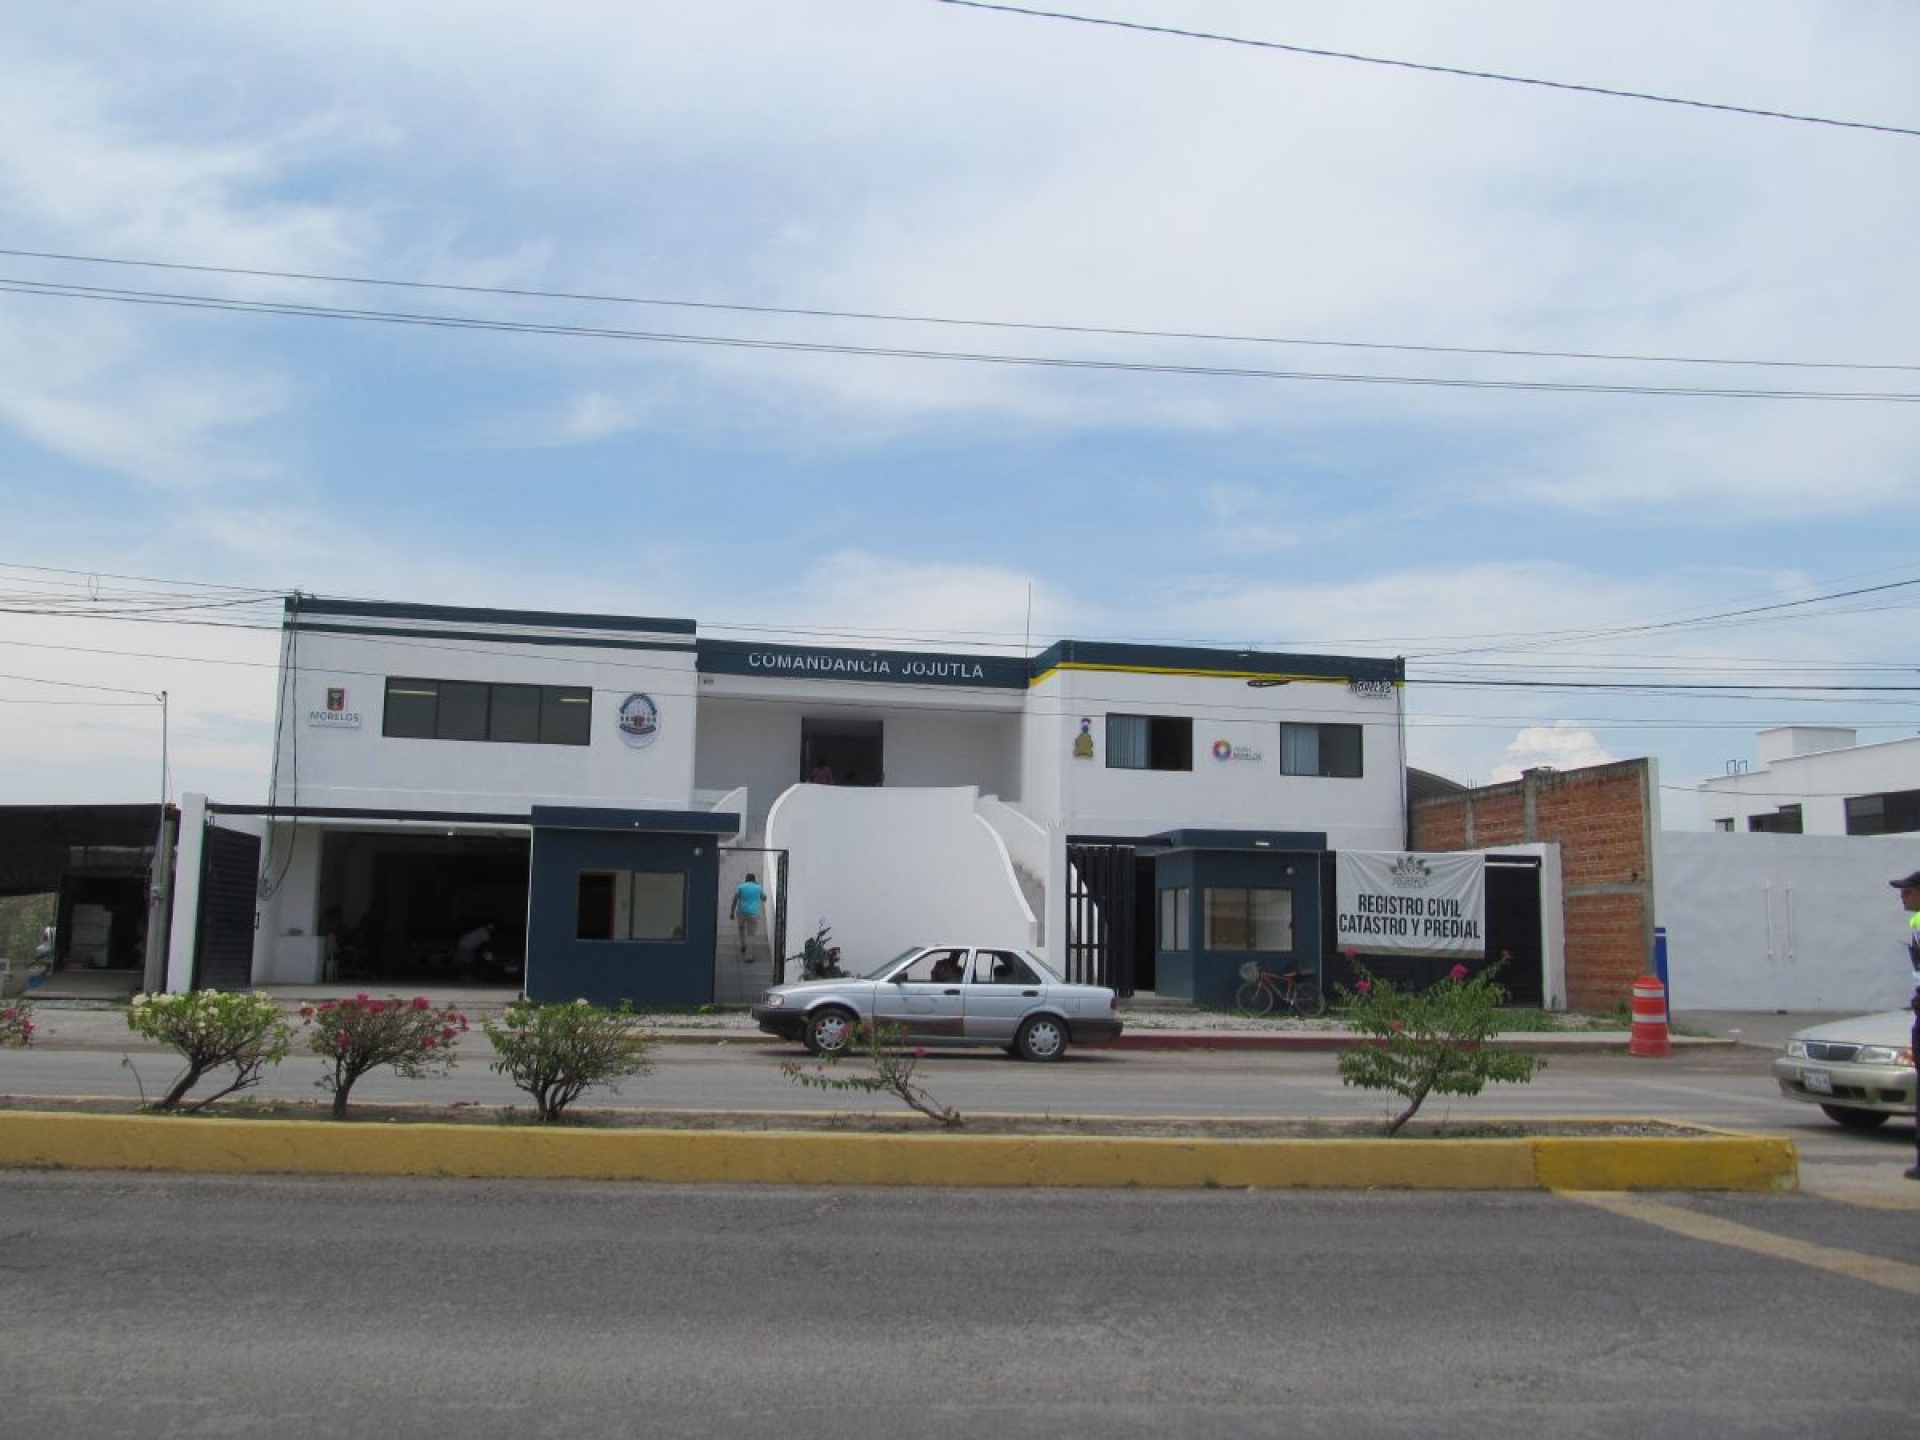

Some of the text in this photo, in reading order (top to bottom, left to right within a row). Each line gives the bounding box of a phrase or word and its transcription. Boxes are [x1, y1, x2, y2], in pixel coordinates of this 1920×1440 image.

[902, 661, 984, 678] JOJUTLA
[1358, 894, 1462, 918] REGISTRO CIVIL
[1339, 914, 1481, 939] CATASTRO Y PREDIAL
